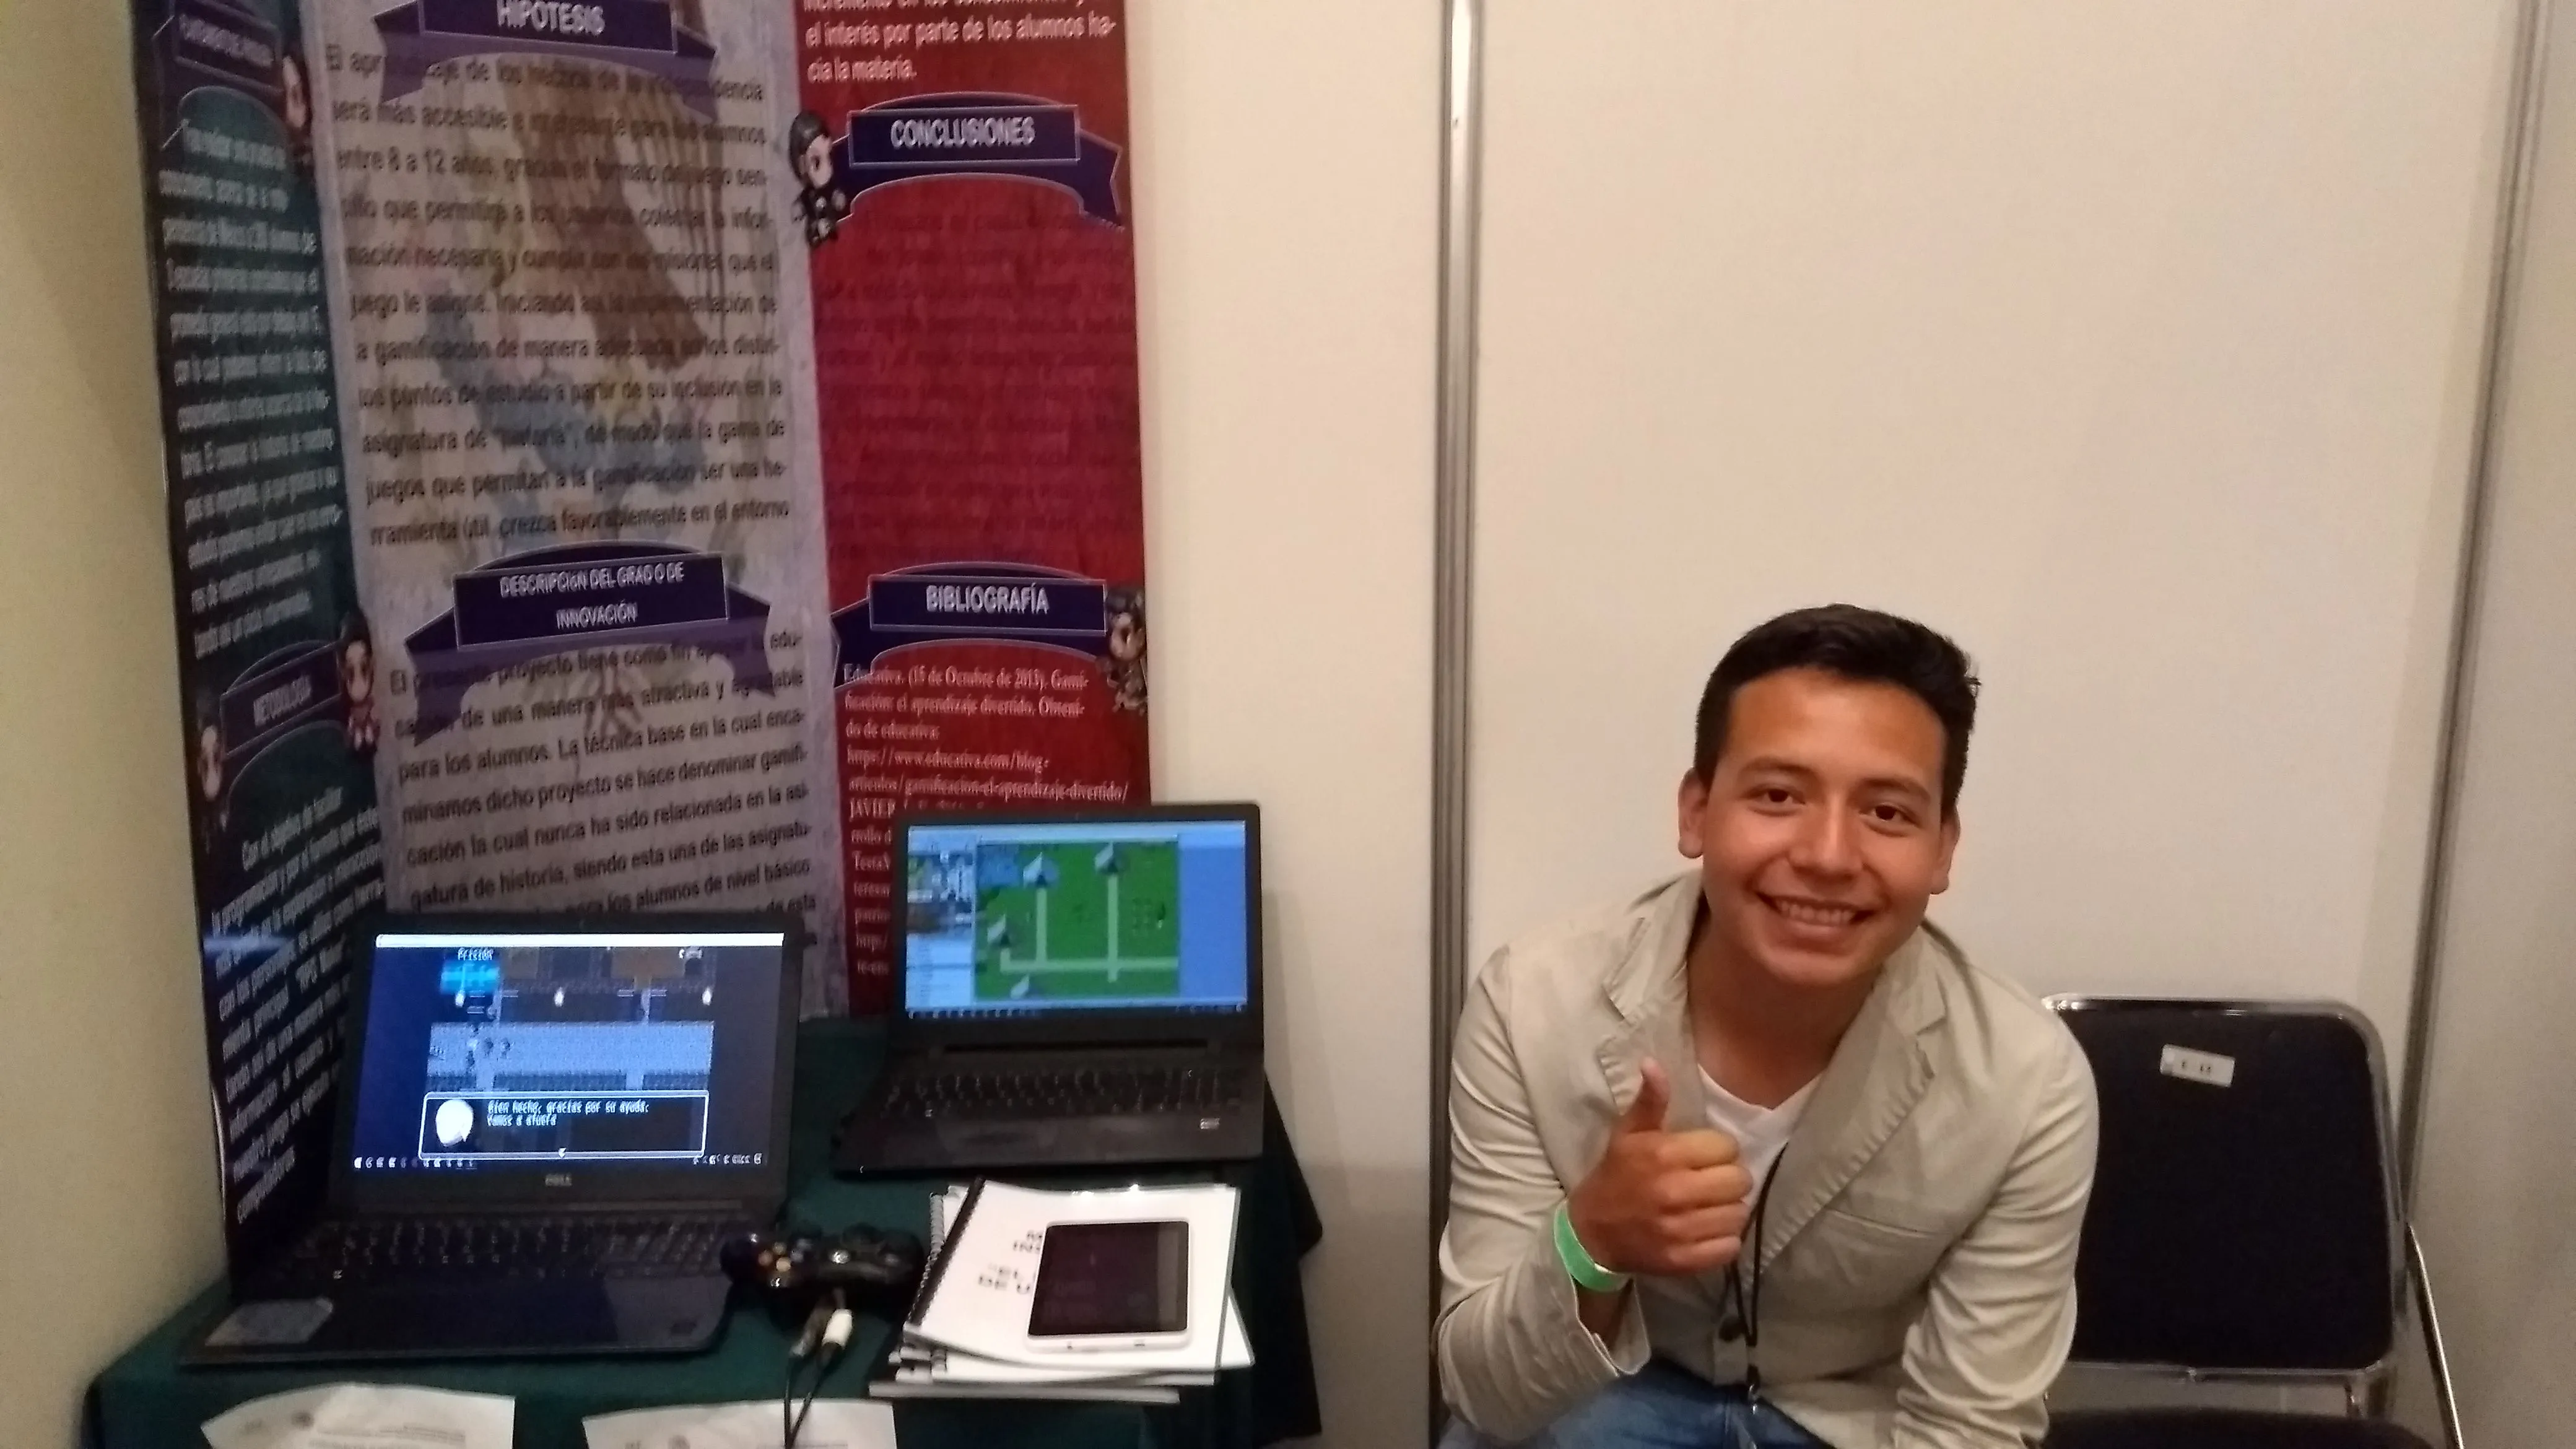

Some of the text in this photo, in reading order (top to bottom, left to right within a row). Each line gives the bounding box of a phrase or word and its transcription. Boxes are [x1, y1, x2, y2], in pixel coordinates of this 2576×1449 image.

[806, 20, 822, 49] el
[915, 17, 960, 51] parte
[962, 15, 985, 42] de
[987, 15, 1013, 42] los
[1016, 12, 1085, 40] alumnos
[890, 116, 1036, 149] CONCLUSIONES
[424, 147, 446, 175] 12
[589, 567, 617, 590] DEL
[666, 560, 685, 582] DE
[556, 598, 638, 629] INNOVACIÓN
[925, 582, 1050, 615] BIBLIOGRAFÍA
[486, 784, 534, 814] dicho
[537, 774, 612, 811] proyecto
[471, 832, 487, 859] la
[493, 824, 529, 856] cual
[534, 820, 586, 848] nunca
[591, 812, 611, 837] ha
[616, 804, 649, 833] sido
[653, 789, 743, 827] relacionada
[746, 790, 765, 811] en
[768, 784, 782, 806] la
[668, 839, 697, 863] una
[700, 830, 720, 858] de
[704, 872, 723, 897] de
[726, 861, 760, 891] nivel
[547, 1100, 583, 1115] gracias
[586, 1100, 602, 1115] por
[605, 1100, 617, 1113] su
